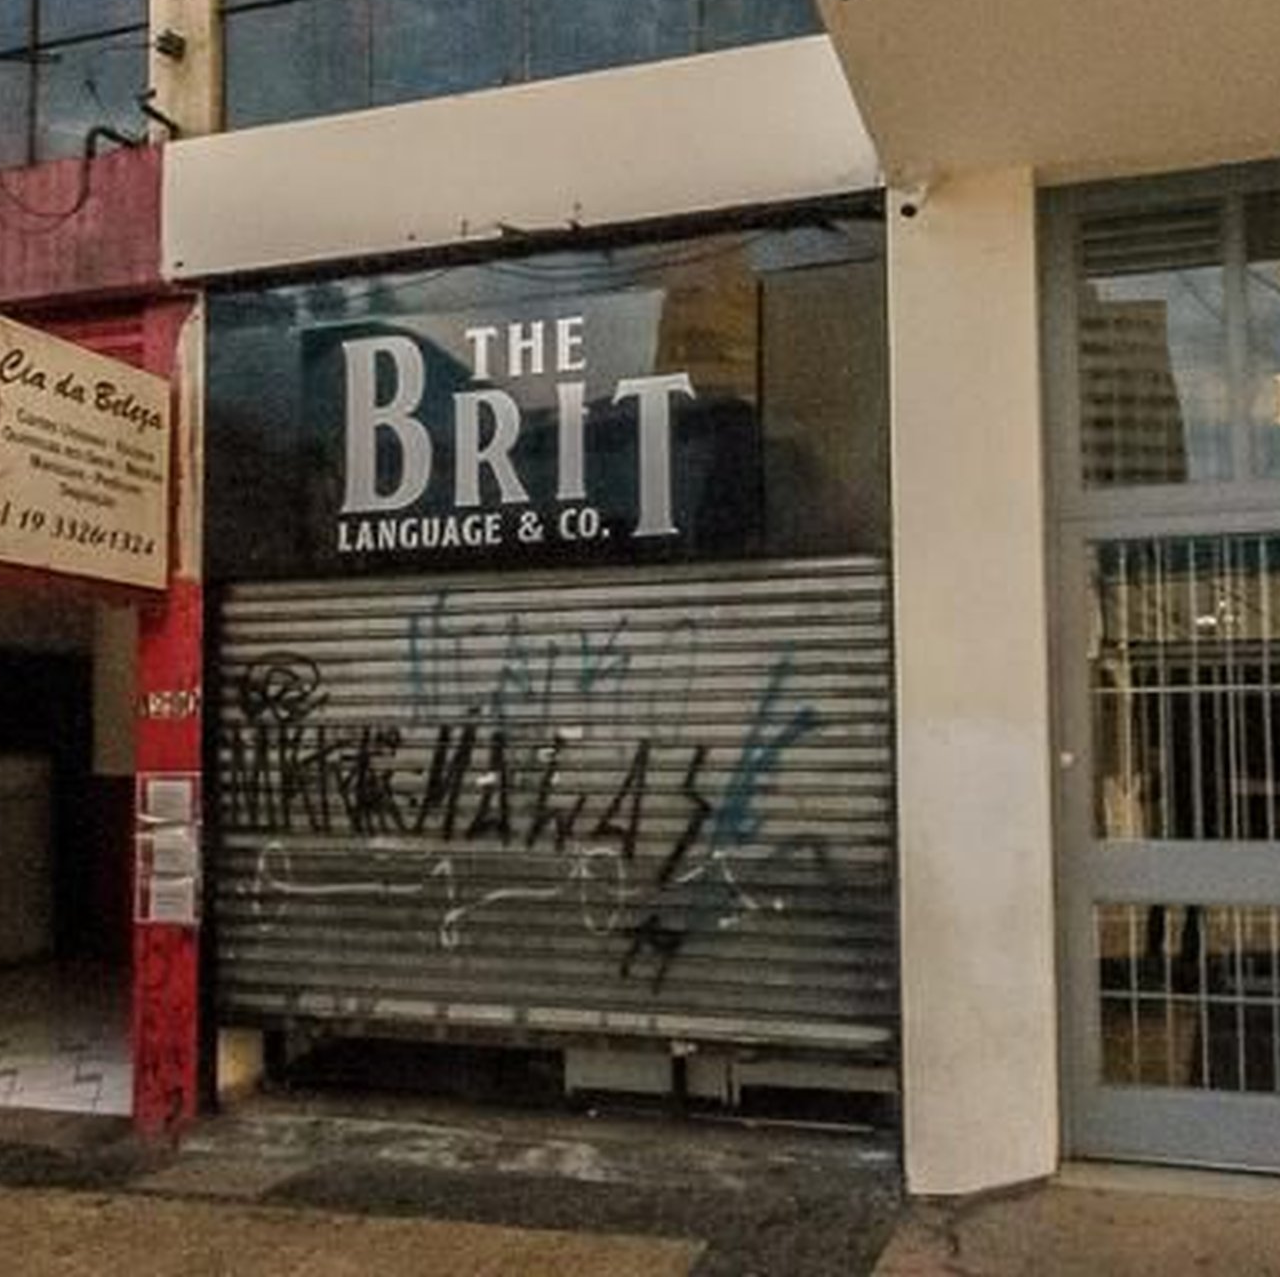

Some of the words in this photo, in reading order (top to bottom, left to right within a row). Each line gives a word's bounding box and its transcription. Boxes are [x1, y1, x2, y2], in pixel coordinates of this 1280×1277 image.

[466, 316, 587, 381] THE
[55, 373, 85, 404] da
[94, 381, 163, 434] Beleza
[341, 335, 697, 538] BRIT
[20, 508, 46, 531] 19
[338, 513, 503, 552] LANGUAGE
[518, 511, 545, 542] &
[560, 507, 611, 539] CO.
